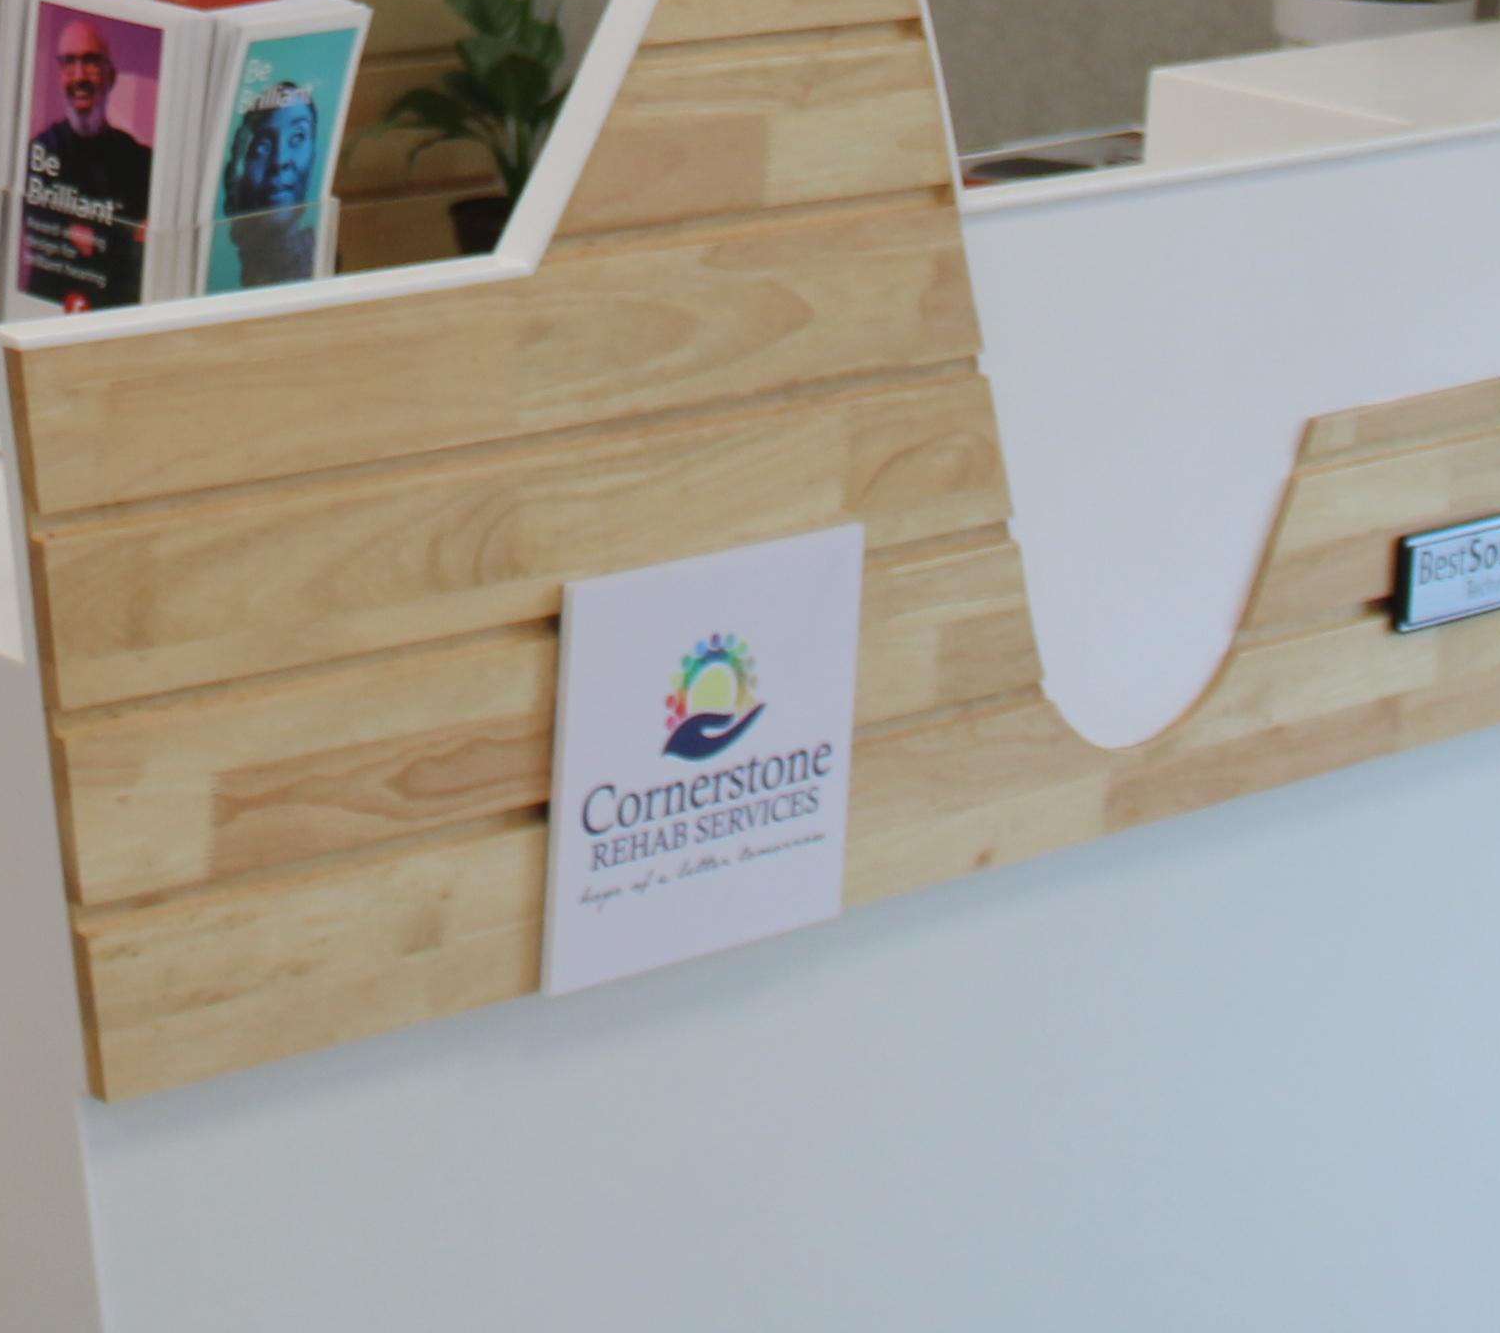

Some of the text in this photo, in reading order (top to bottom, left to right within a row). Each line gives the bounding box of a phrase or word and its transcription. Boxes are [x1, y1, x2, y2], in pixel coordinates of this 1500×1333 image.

[243, 58, 274, 84] Be
[29, 142, 61, 177] Be
[26, 176, 115, 227] Brilliant
[580, 741, 834, 837] Cornerstone
[589, 785, 821, 873] REHAB SERVICES
